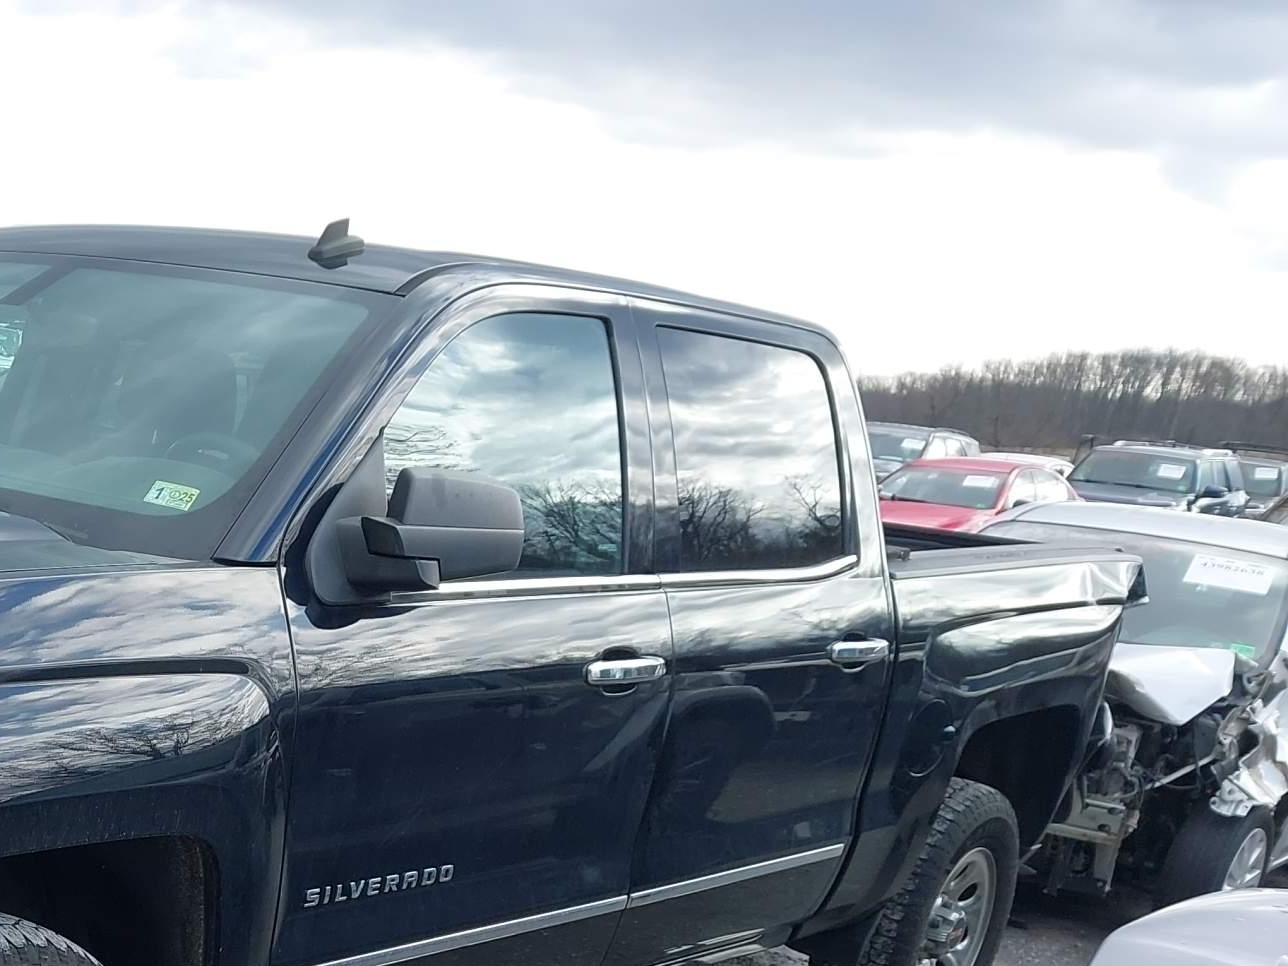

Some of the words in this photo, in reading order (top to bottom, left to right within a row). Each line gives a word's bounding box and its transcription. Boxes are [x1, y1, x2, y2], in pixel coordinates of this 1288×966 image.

[155, 487, 165, 499] 1
[177, 492, 195, 503] 25
[303, 864, 454, 908] SILVERADO
